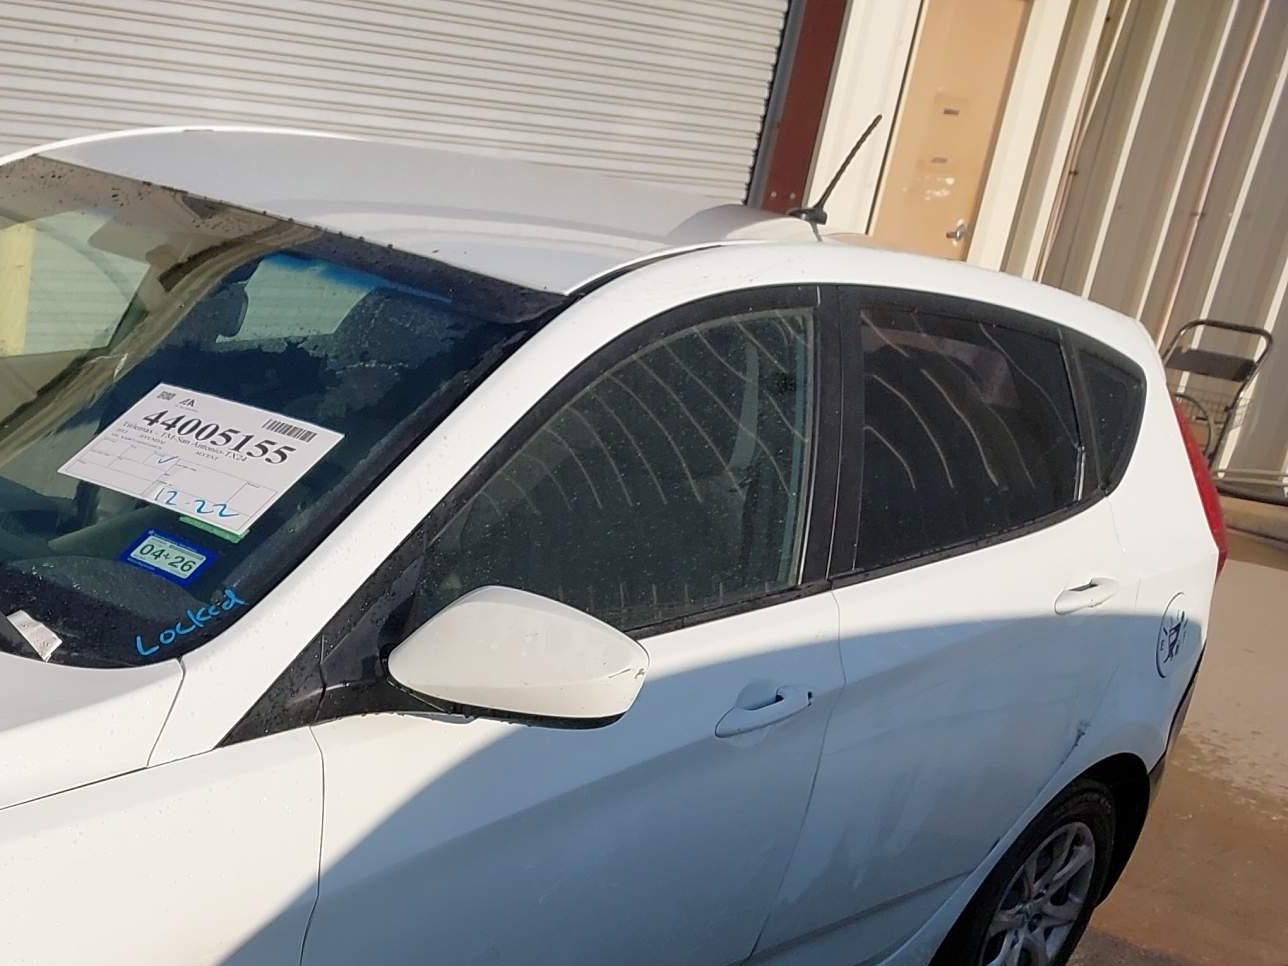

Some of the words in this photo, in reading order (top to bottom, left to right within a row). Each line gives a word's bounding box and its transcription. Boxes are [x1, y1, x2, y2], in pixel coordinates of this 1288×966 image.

[143, 410, 297, 465] 44005155
[140, 544, 166, 561] 04
[167, 555, 196, 573] 26
[136, 587, 246, 656] Locked
